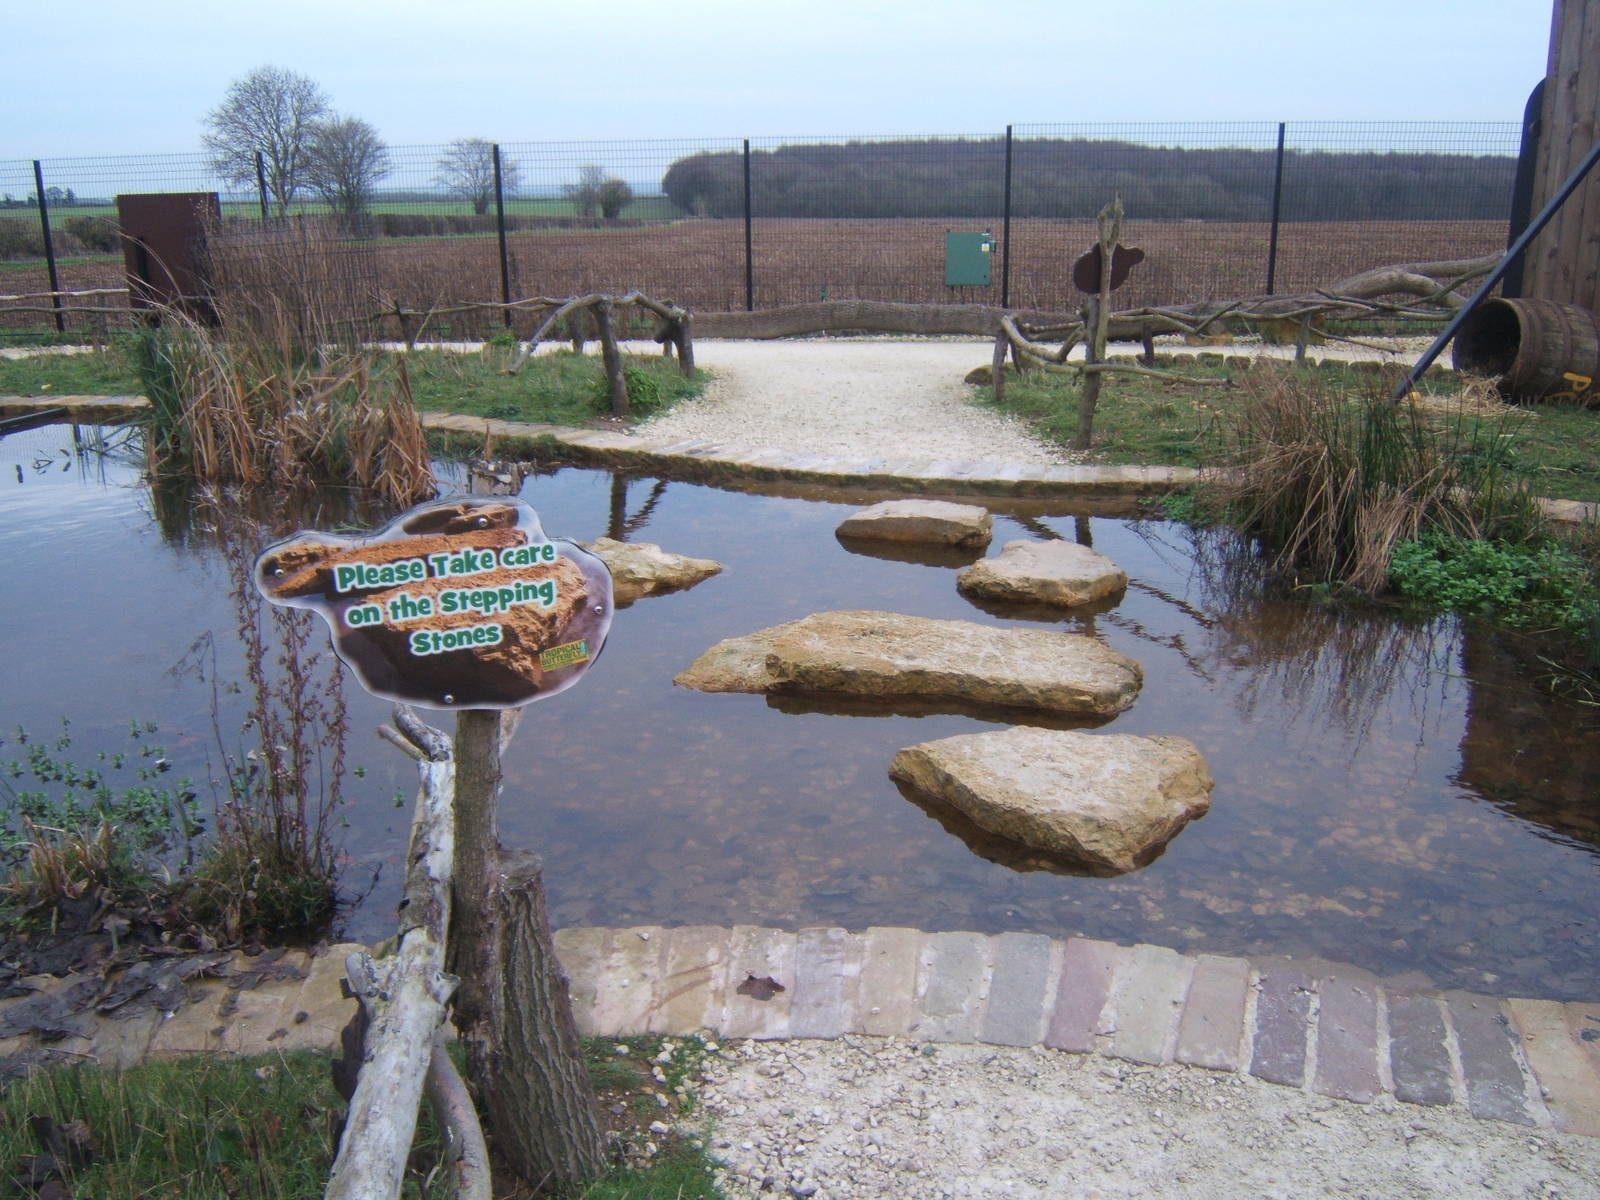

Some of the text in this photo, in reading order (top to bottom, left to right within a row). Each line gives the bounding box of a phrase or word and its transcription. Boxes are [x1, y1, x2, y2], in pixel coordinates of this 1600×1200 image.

[337, 544, 554, 589] Please Take care
[348, 581, 554, 625] on the Stepping
[412, 625, 501, 654] Stones
[541, 643, 581, 659] TROPICAL
